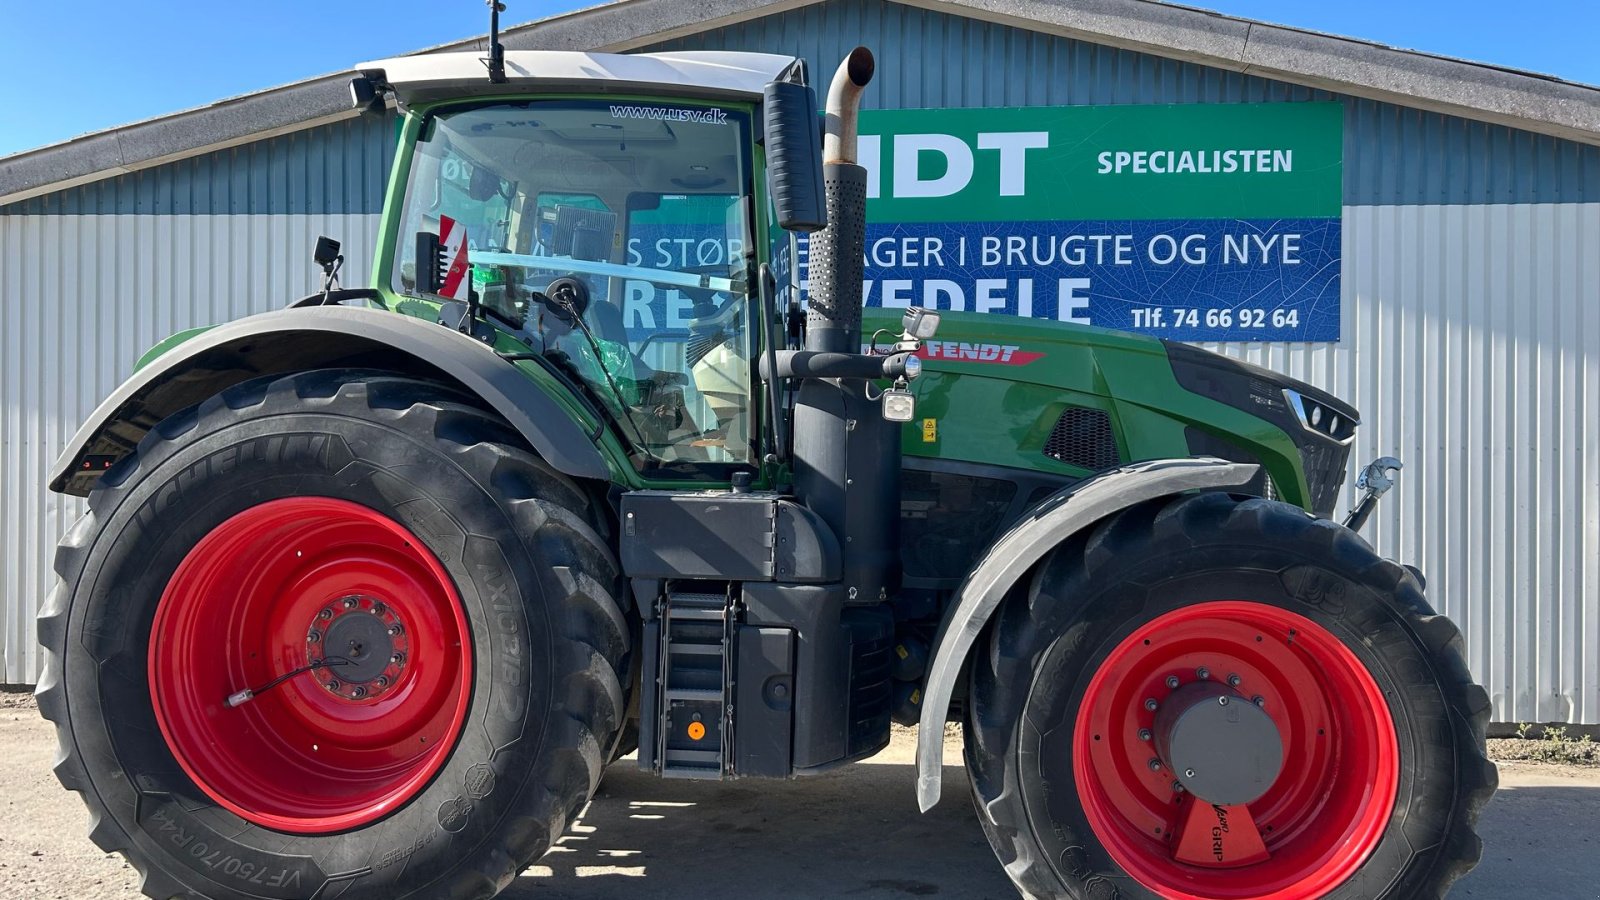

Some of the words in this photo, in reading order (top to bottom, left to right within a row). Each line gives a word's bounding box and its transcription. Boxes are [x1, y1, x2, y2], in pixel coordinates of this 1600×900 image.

[609, 105, 728, 125] www.usv.dk
[1097, 150, 1293, 174] SPECIALISTEN
[959, 237, 966, 266] I
[982, 235, 1133, 266] BRUGTE
[1148, 235, 1206, 265] OG
[1224, 234, 1301, 265] NYE
[1131, 309, 1167, 328] Tlf.
[1173, 309, 1199, 328] 74
[1205, 309, 1232, 328] 66
[1239, 309, 1265, 328] 92
[1271, 308, 1299, 328] 64
[925, 340, 1020, 362] FENDT
[1212, 827, 1223, 862] GRIP
